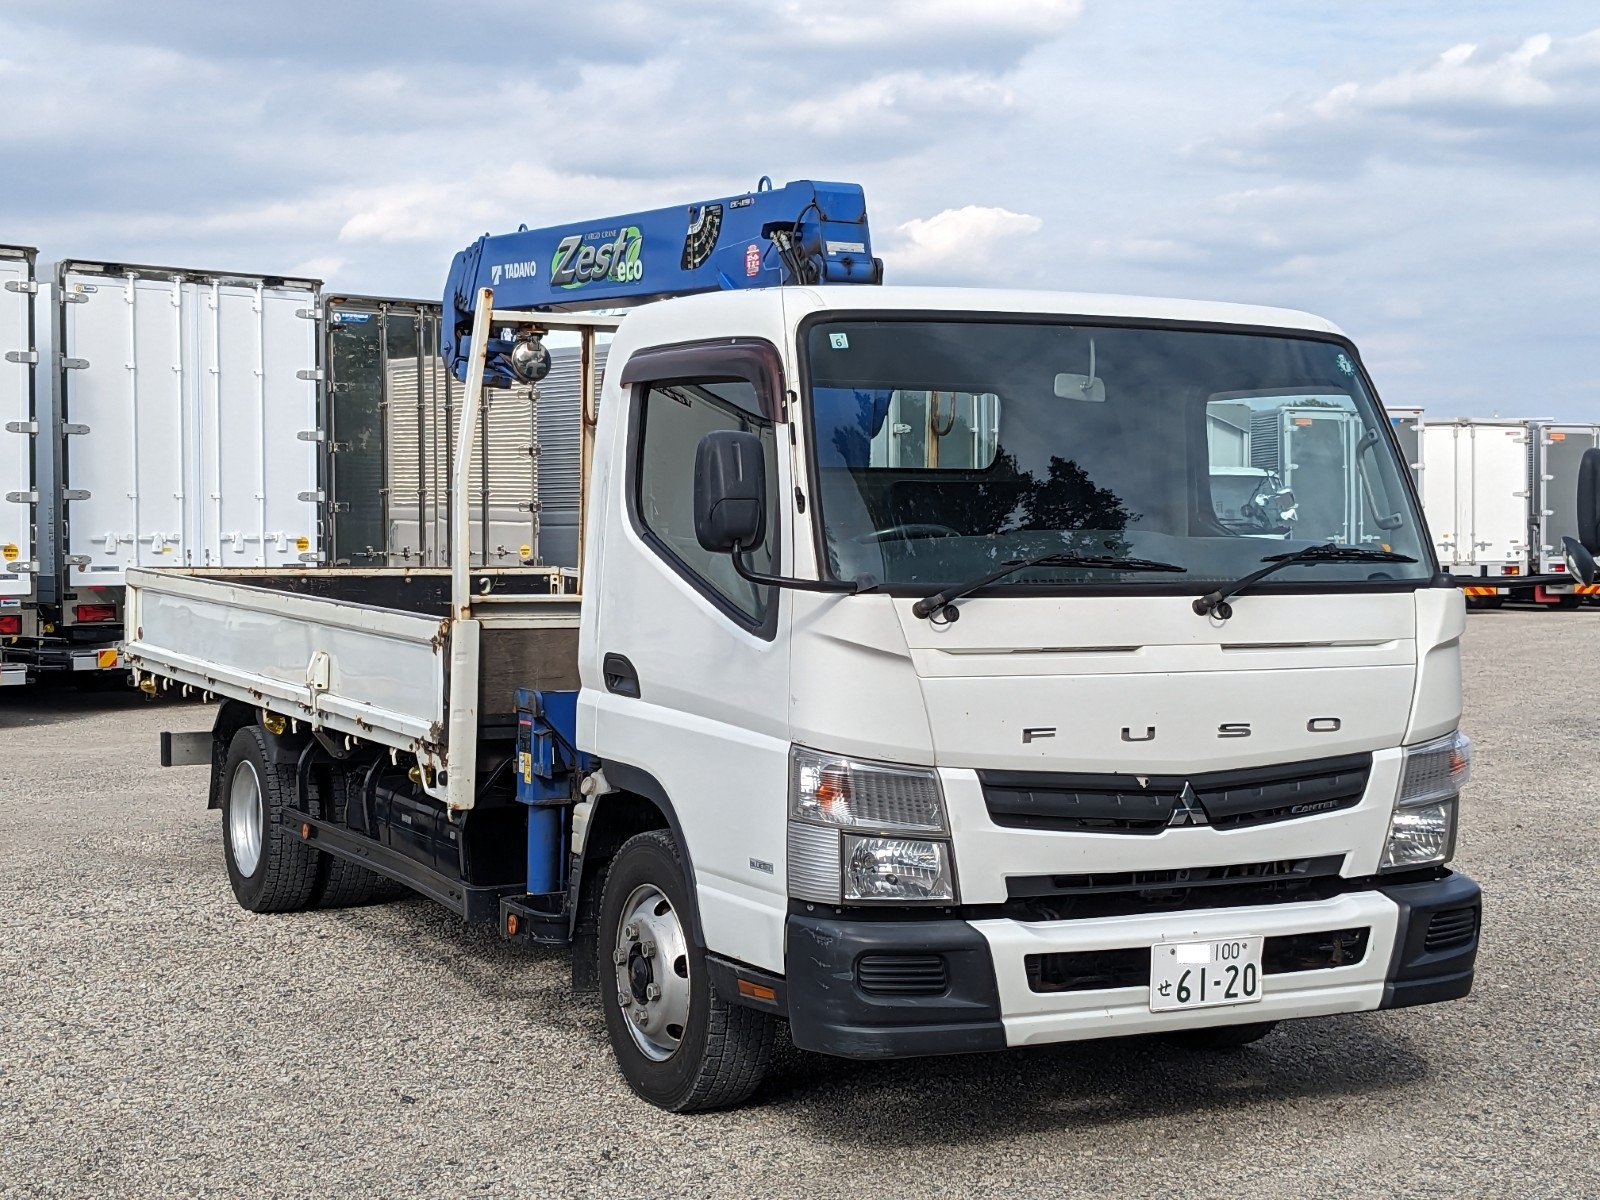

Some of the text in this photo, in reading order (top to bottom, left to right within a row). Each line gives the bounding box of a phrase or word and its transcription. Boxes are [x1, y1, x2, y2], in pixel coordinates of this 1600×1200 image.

[601, 229, 617, 239] CRANE
[550, 227, 628, 285] Zest
[504, 260, 537, 280] TADANO
[617, 259, 643, 282] eco
[835, 338, 843, 348] 6
[1022, 717, 1341, 744] FUSO
[1291, 799, 1339, 814] CANTER
[1215, 942, 1240, 962] 100
[1157, 962, 1257, 1004] せ 61-20
